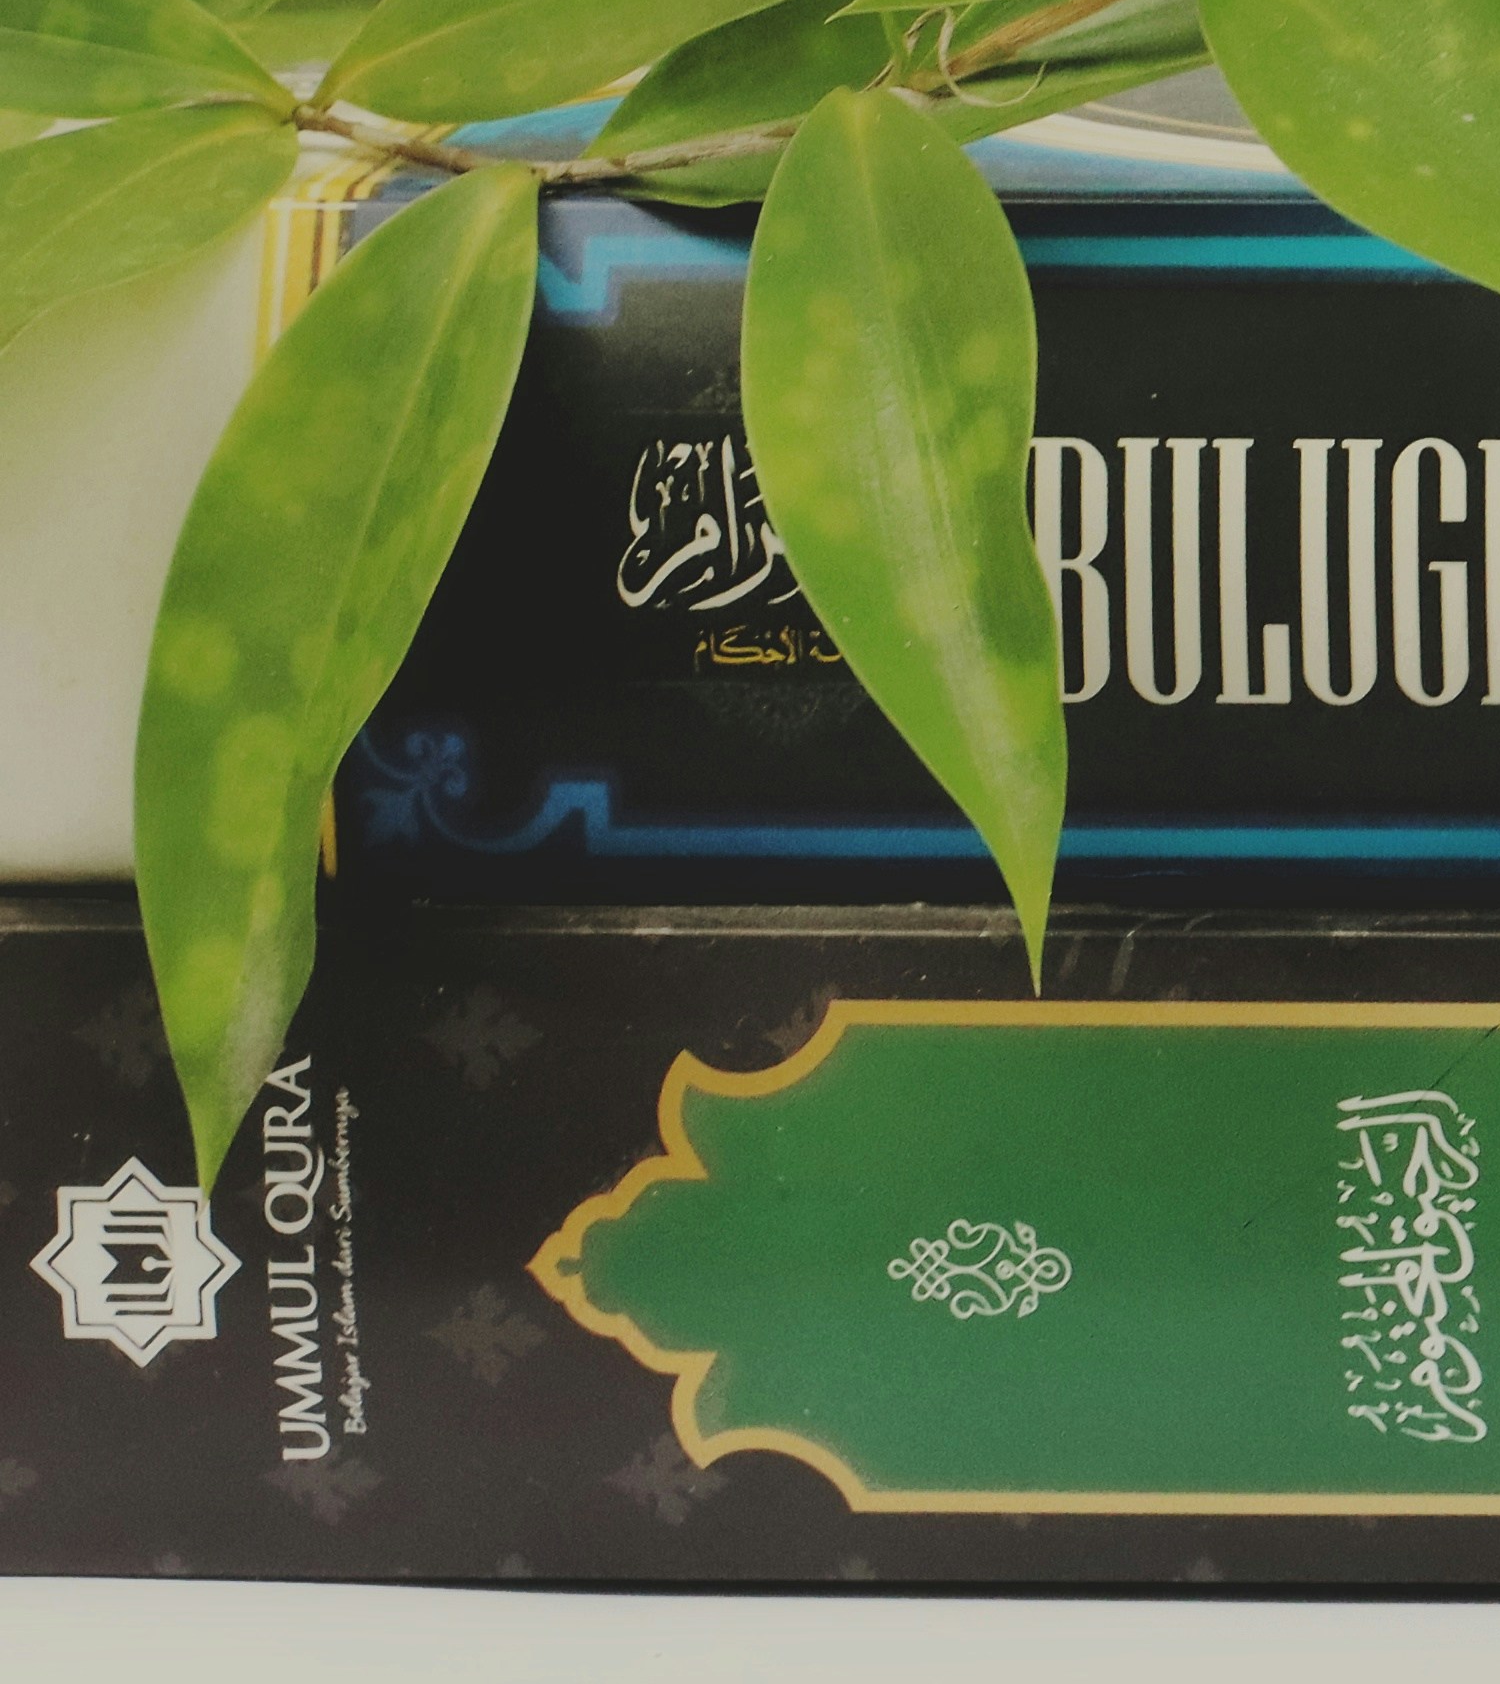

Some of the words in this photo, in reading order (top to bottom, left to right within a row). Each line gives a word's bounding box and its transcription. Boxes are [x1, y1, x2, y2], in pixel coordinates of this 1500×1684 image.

[263, 1054, 325, 1235] QURA
[268, 1243, 331, 1461] UMMUL
[331, 1281, 359, 1347] Islam
